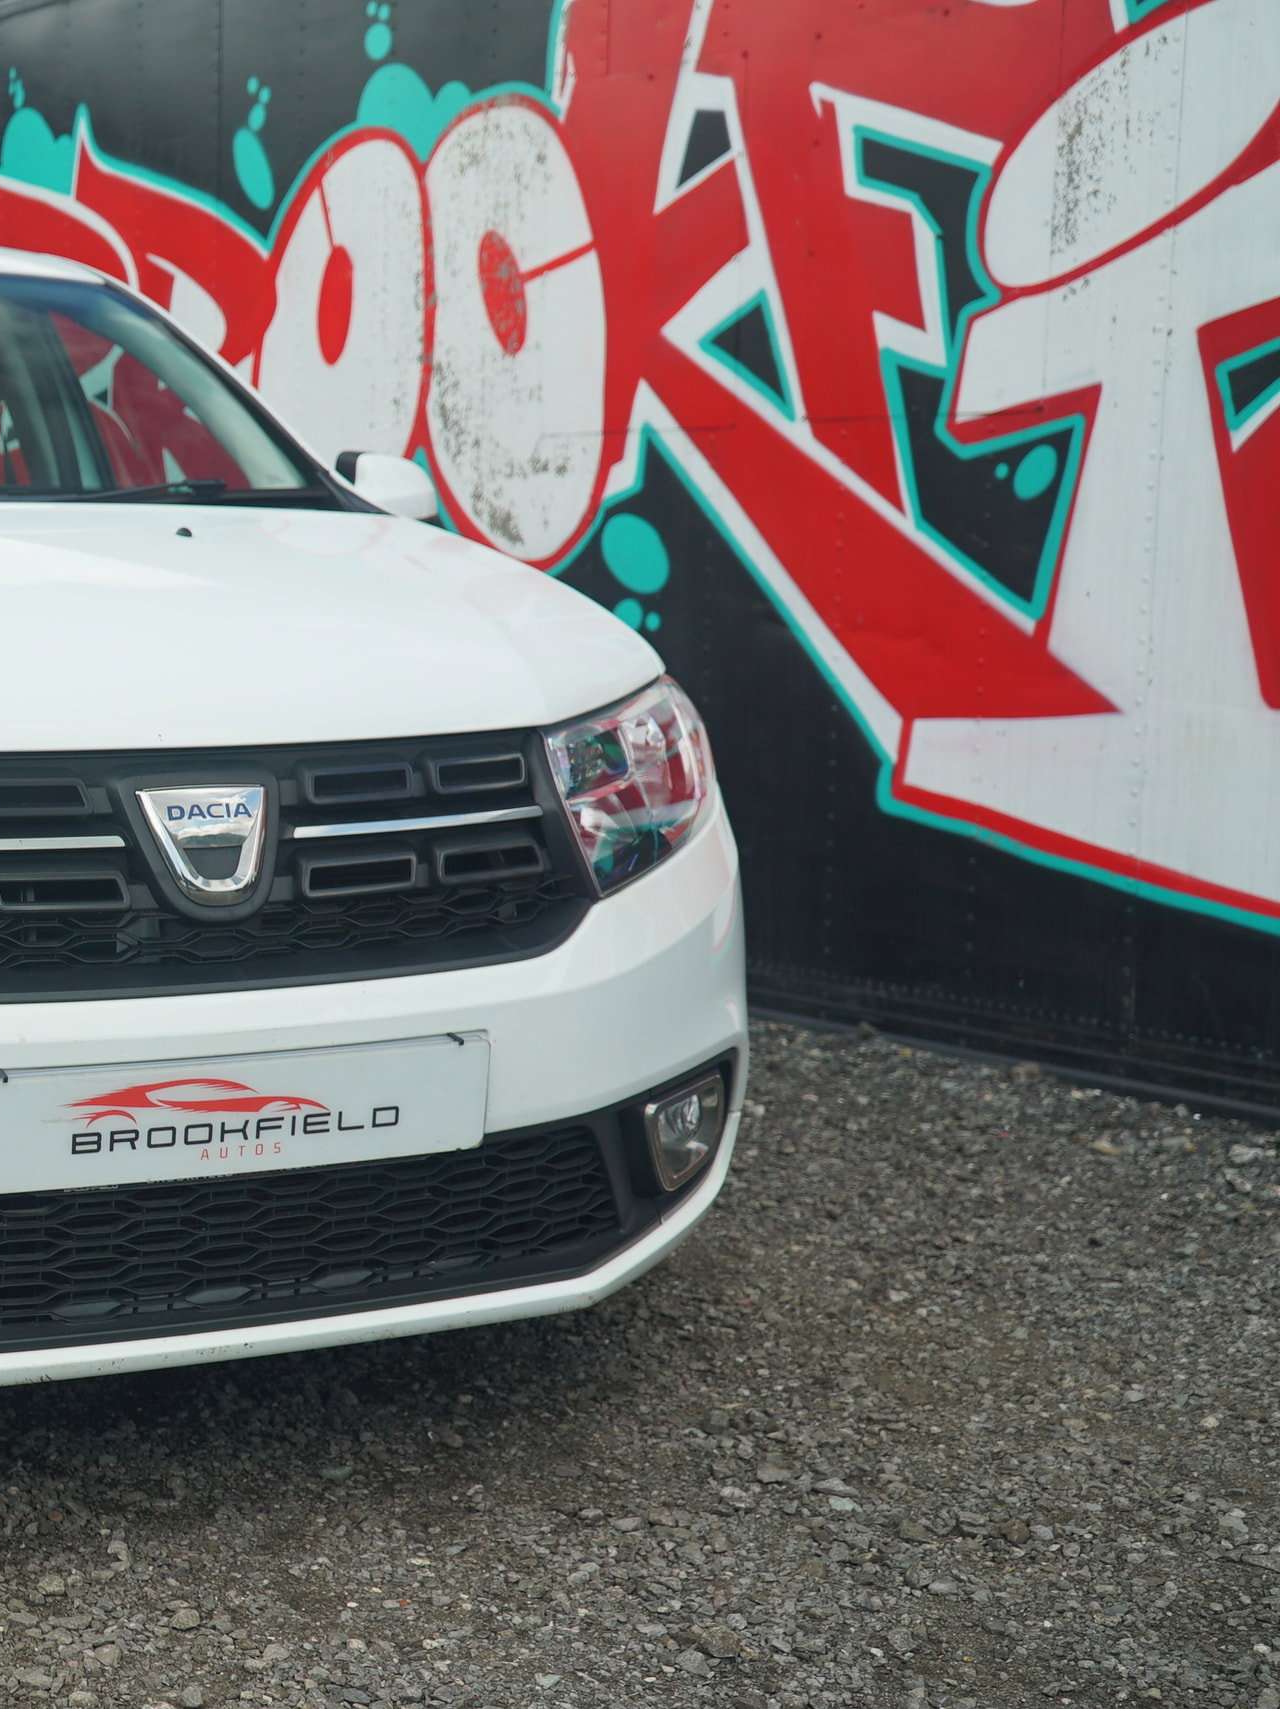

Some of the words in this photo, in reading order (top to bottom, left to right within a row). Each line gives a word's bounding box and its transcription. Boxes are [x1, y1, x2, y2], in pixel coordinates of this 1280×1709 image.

[167, 803, 252, 821] DACIA
[71, 1106, 400, 1155] BROOKFIELD
[200, 1142, 282, 1161] AUTOS
